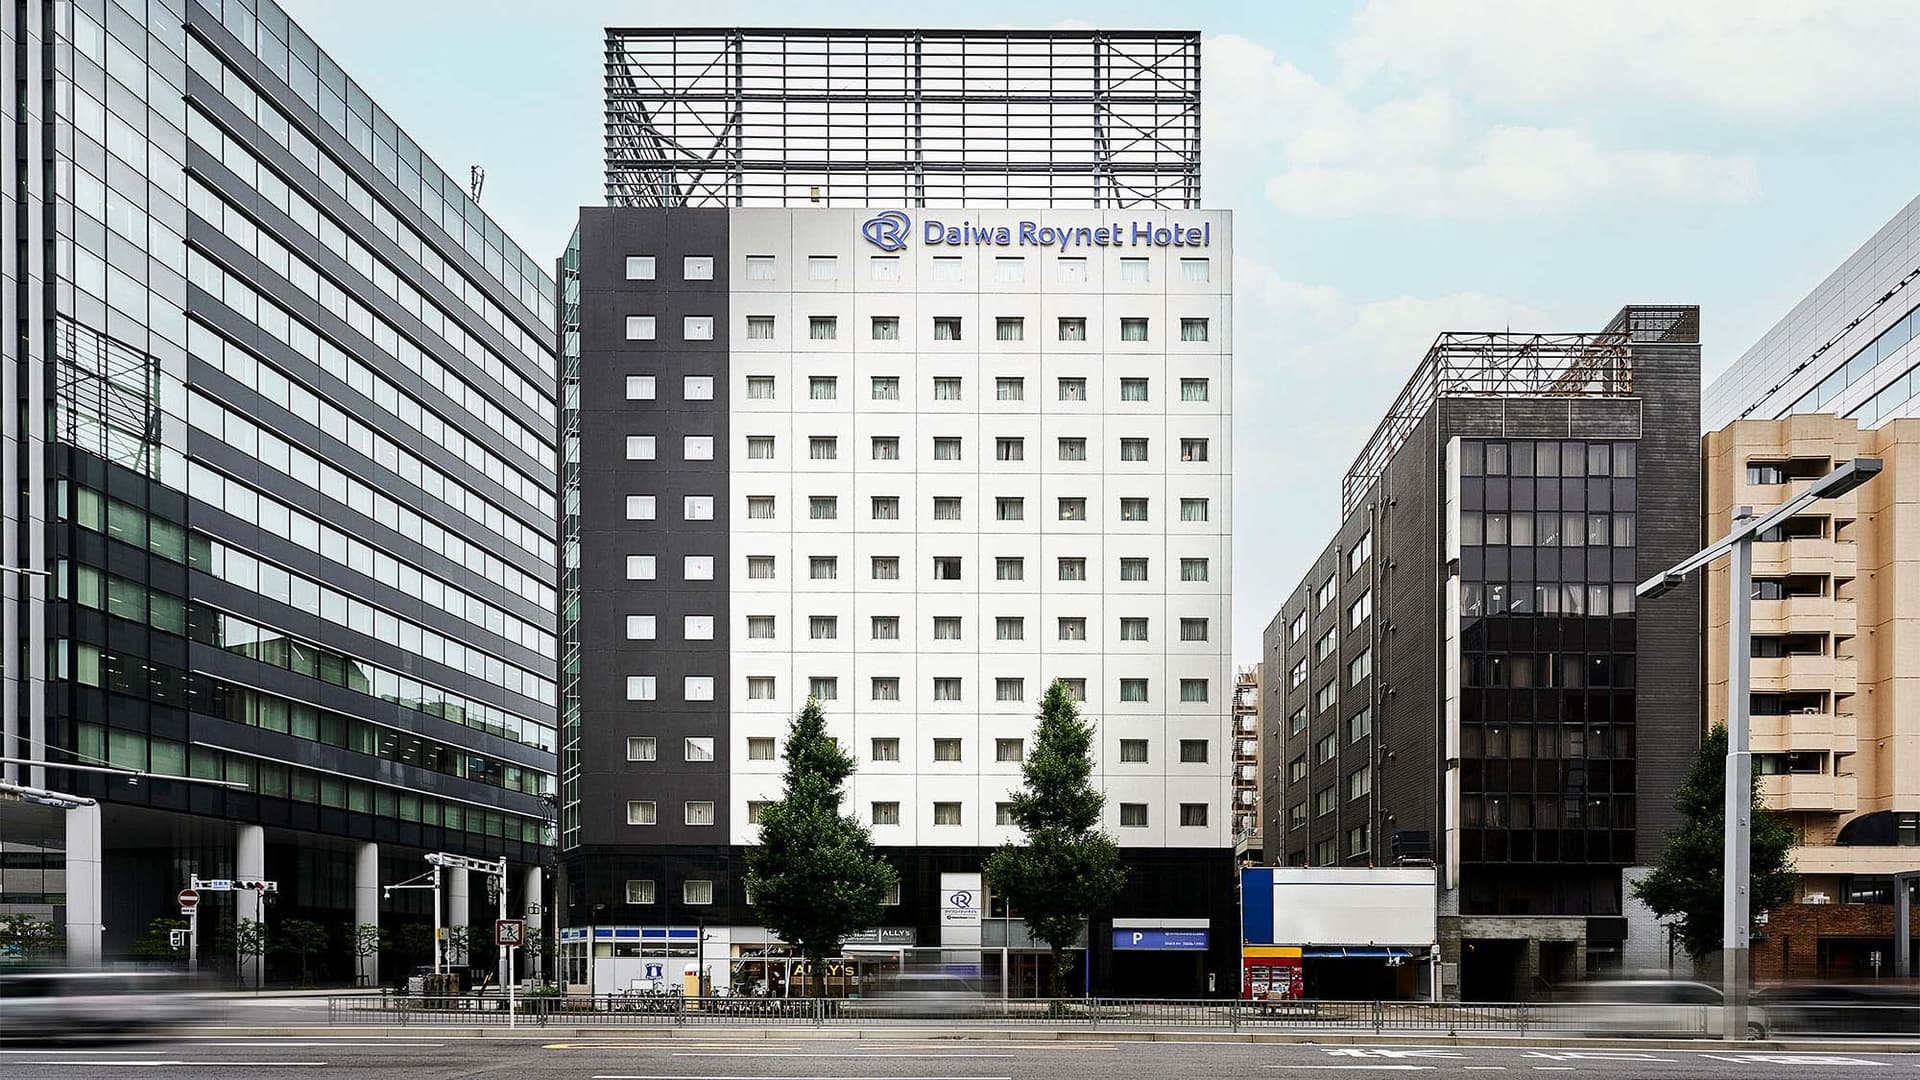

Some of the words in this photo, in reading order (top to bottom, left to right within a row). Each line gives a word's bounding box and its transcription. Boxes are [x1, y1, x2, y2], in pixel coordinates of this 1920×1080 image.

[924, 220, 1011, 246] Daiwa
[1019, 220, 1124, 252] Roynet
[1131, 220, 1211, 246] Hotel
[1132, 932, 1143, 945] P
